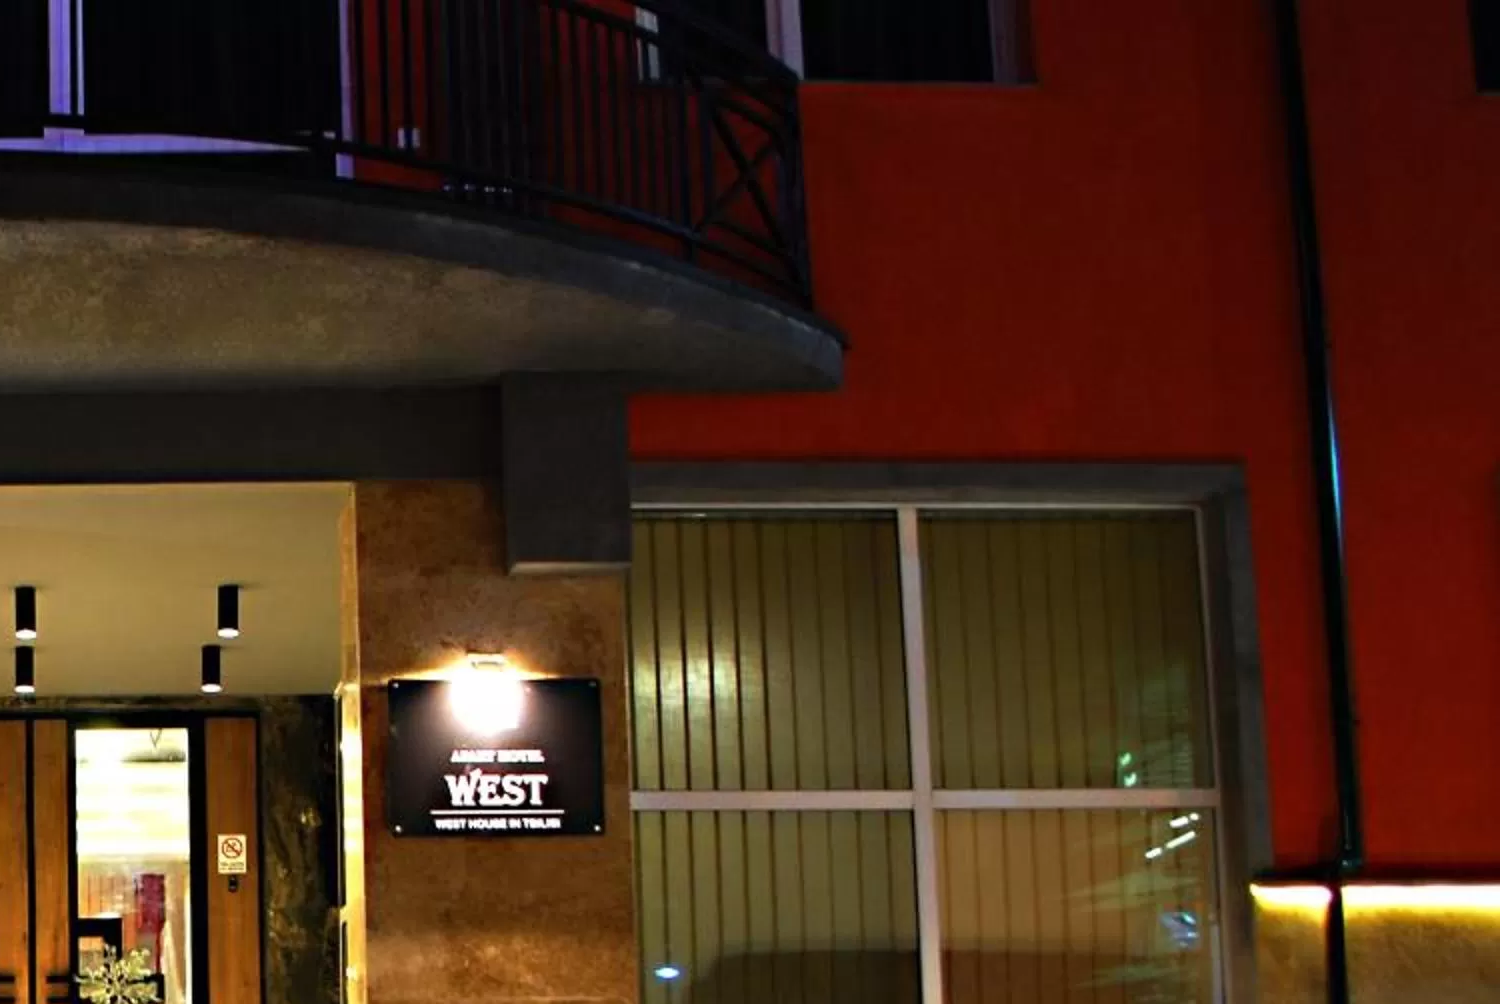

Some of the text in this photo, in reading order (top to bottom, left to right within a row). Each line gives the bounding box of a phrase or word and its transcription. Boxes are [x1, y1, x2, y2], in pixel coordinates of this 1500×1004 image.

[444, 768, 549, 806] WEST
[435, 818, 466, 830] WEST
[468, 818, 507, 830] HOUSE
